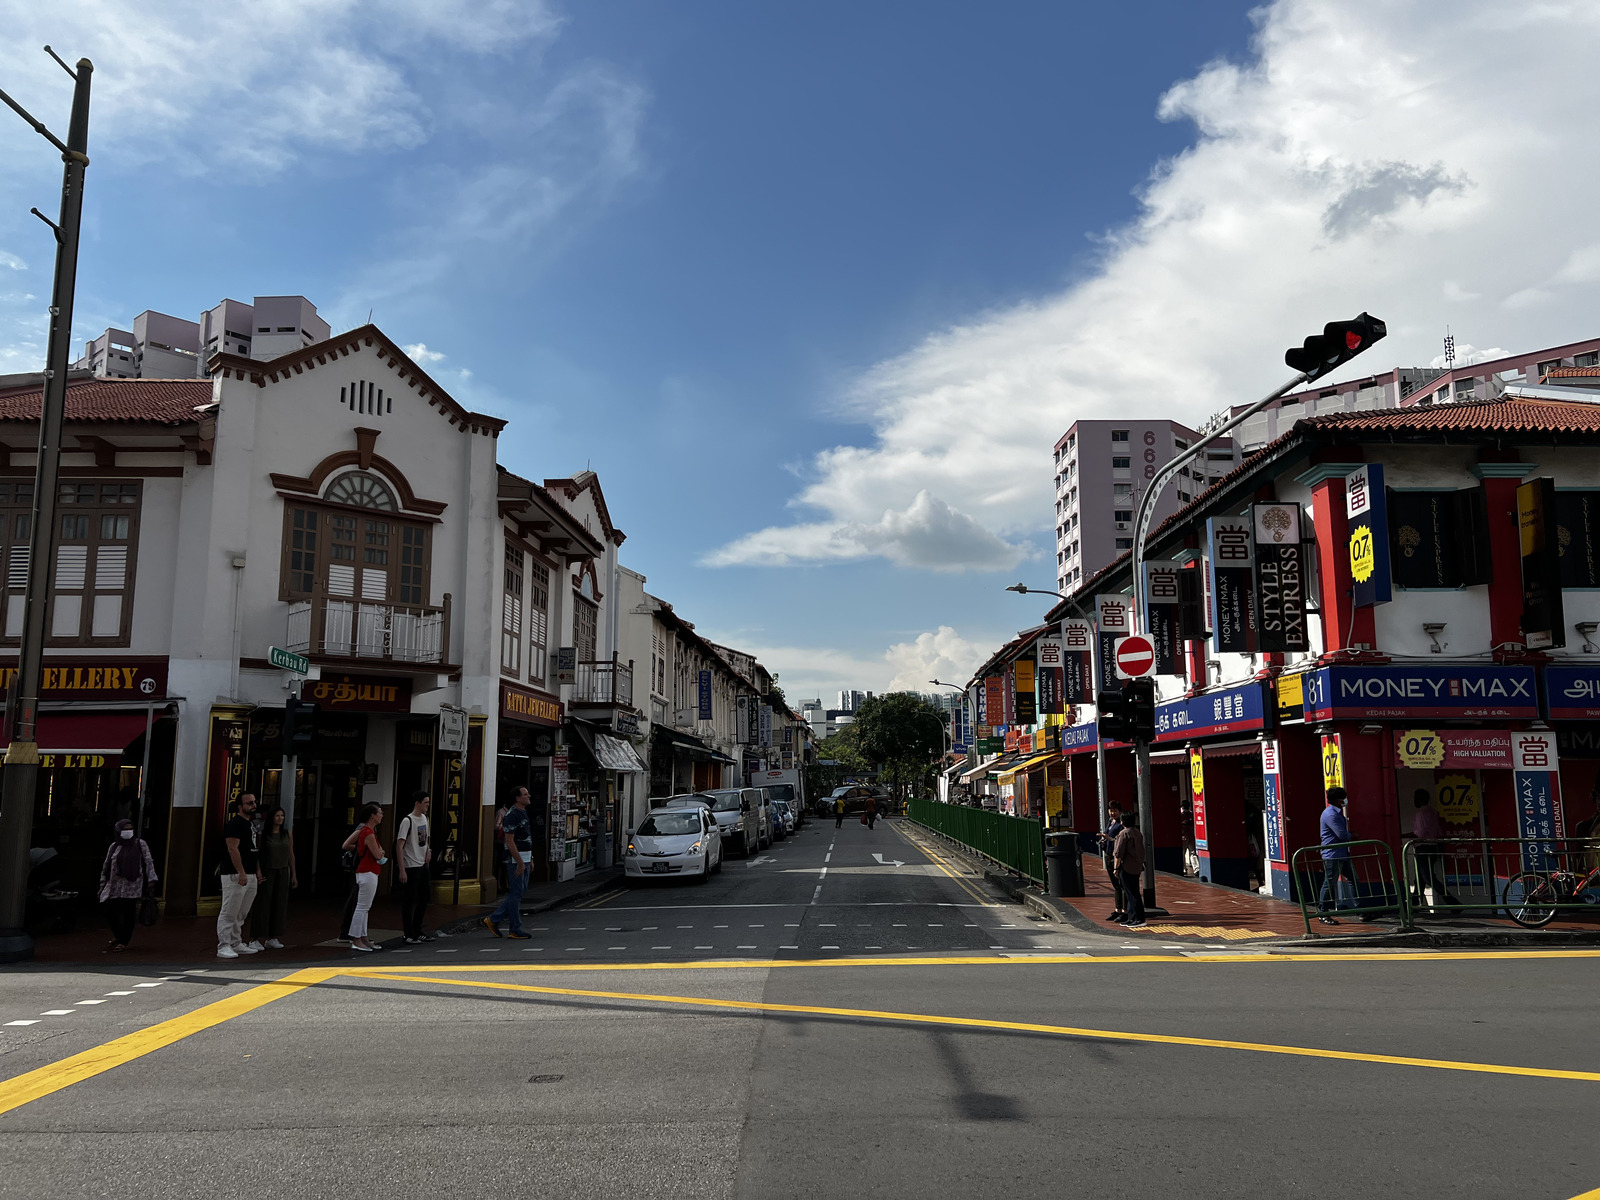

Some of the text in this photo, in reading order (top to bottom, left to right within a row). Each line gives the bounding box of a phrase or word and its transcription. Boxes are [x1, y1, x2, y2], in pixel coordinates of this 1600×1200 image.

[1144, 430, 1156, 479] 668
[1219, 576, 1231, 645] MONEY MAX
[1246, 589, 1255, 630] OPEN DAILY
[1261, 562, 1282, 632] STYLE
[1280, 547, 1304, 646] EXPRESS
[273, 649, 307, 672] Kerbau Rd
[1308, 676, 1324, 705] 81
[1340, 678, 1447, 698] MONEY
[1461, 678, 1531, 698] MAX
[506, 691, 560, 722] SATYA JEWELLERY
[1366, 710, 1406, 718] KEDAI PAJAK
[63, 754, 105, 768] LTD
[1406, 737, 1437, 756] 0.7%
[1453, 749, 1506, 758] HIGH VALUATION
[448, 758, 463, 843] SATYA
[1440, 784, 1473, 806] 0.7%
[1521, 777, 1535, 810] MAX
[1552, 799, 1561, 824] DAILY
[1267, 814, 1275, 855] MONEY
